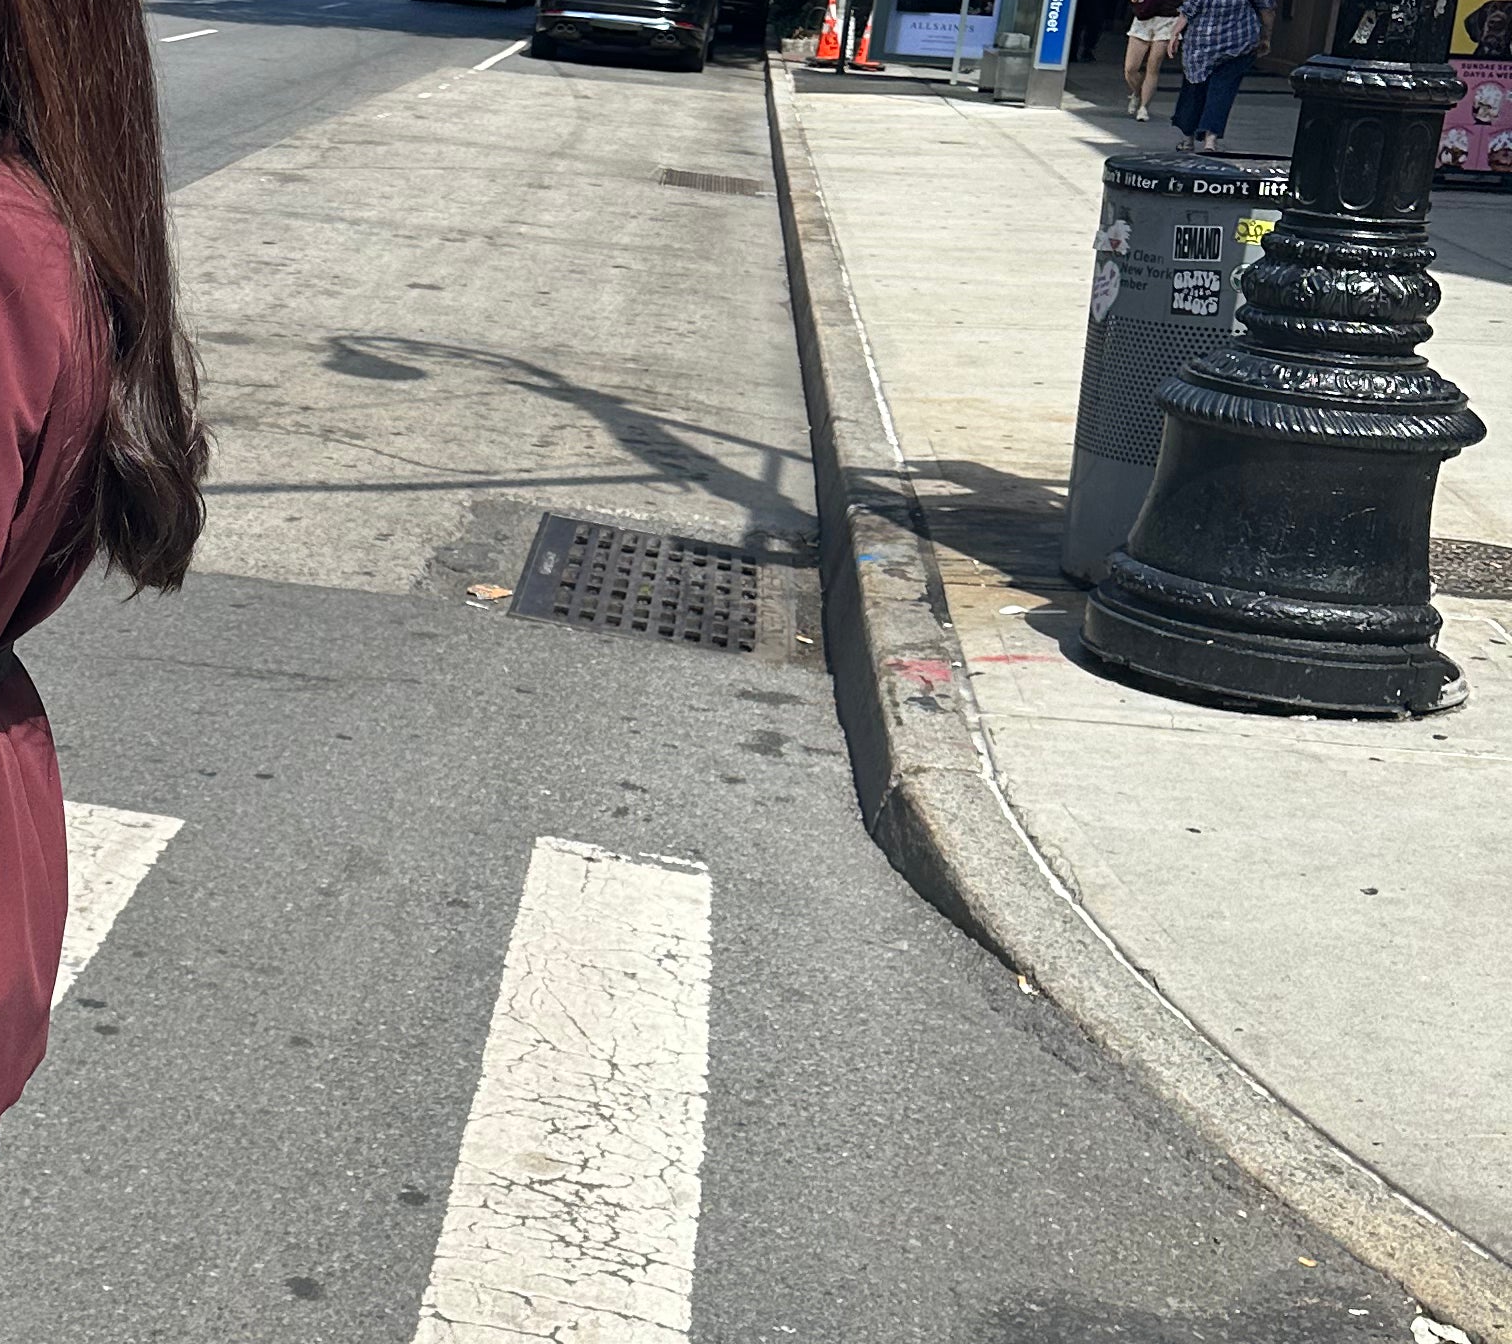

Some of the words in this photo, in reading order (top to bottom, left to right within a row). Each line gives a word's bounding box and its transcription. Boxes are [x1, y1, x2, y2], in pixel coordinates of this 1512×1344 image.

[910, 21, 975, 33] ALLSAINS
[1461, 63, 1495, 71] SUNDAE
[1463, 70, 1486, 78] DAYS
[1124, 172, 1159, 189] litter
[1193, 180, 1250, 195] Don't
[1258, 182, 1289, 196] litt
[1133, 248, 1165, 264] Clean
[1120, 262, 1145, 276] New
[1144, 265, 1173, 279] York
[1173, 270, 1221, 292] GRAVE
